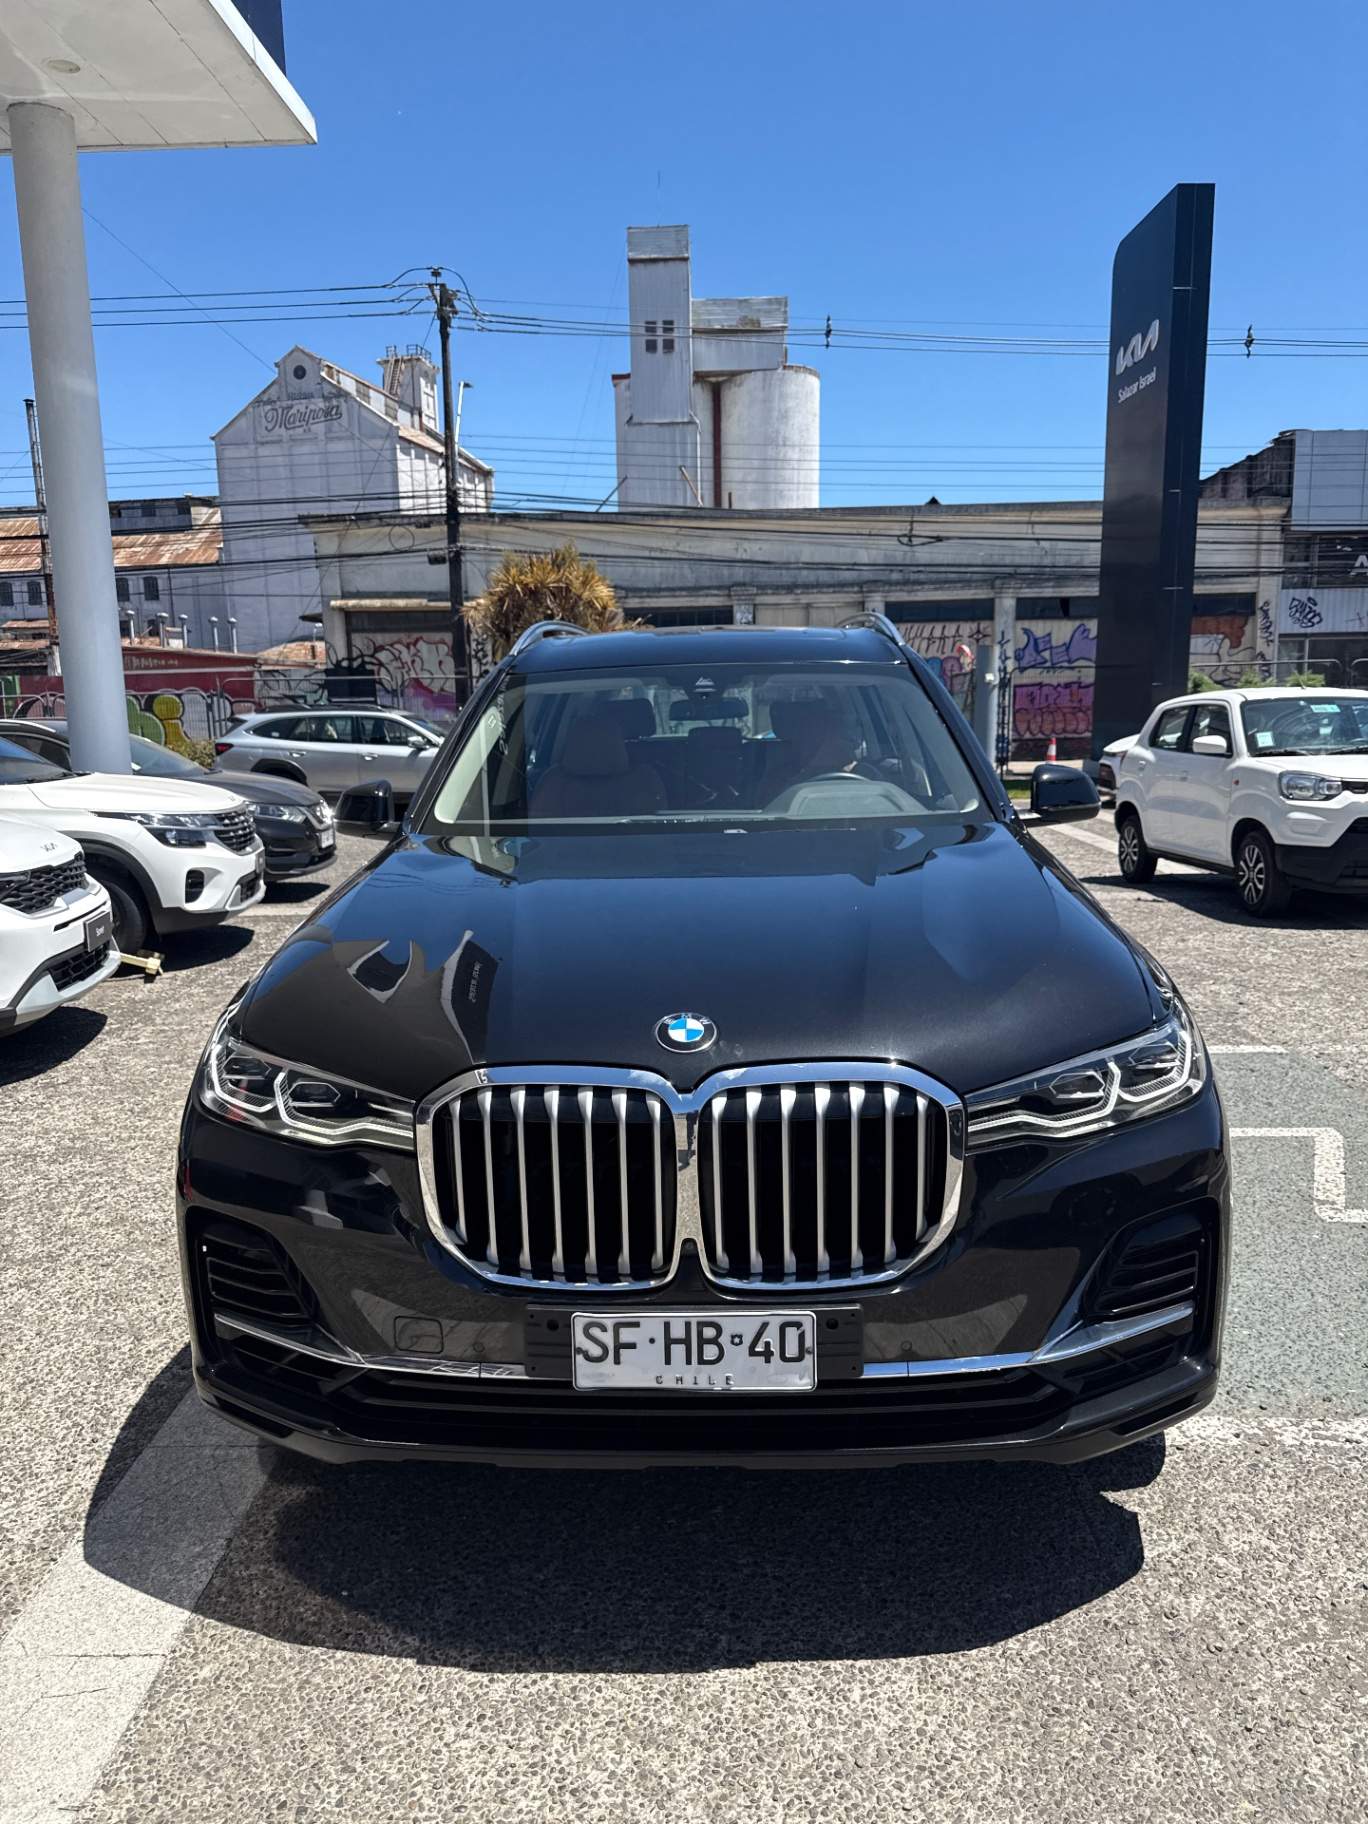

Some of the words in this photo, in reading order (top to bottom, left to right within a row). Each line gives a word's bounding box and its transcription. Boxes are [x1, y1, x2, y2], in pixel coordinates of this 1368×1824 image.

[1118, 381, 1139, 403] Salazar
[1139, 366, 1157, 390] Israel
[264, 404, 343, 433] Mariposa
[655, 1374, 734, 1386] CHILE
